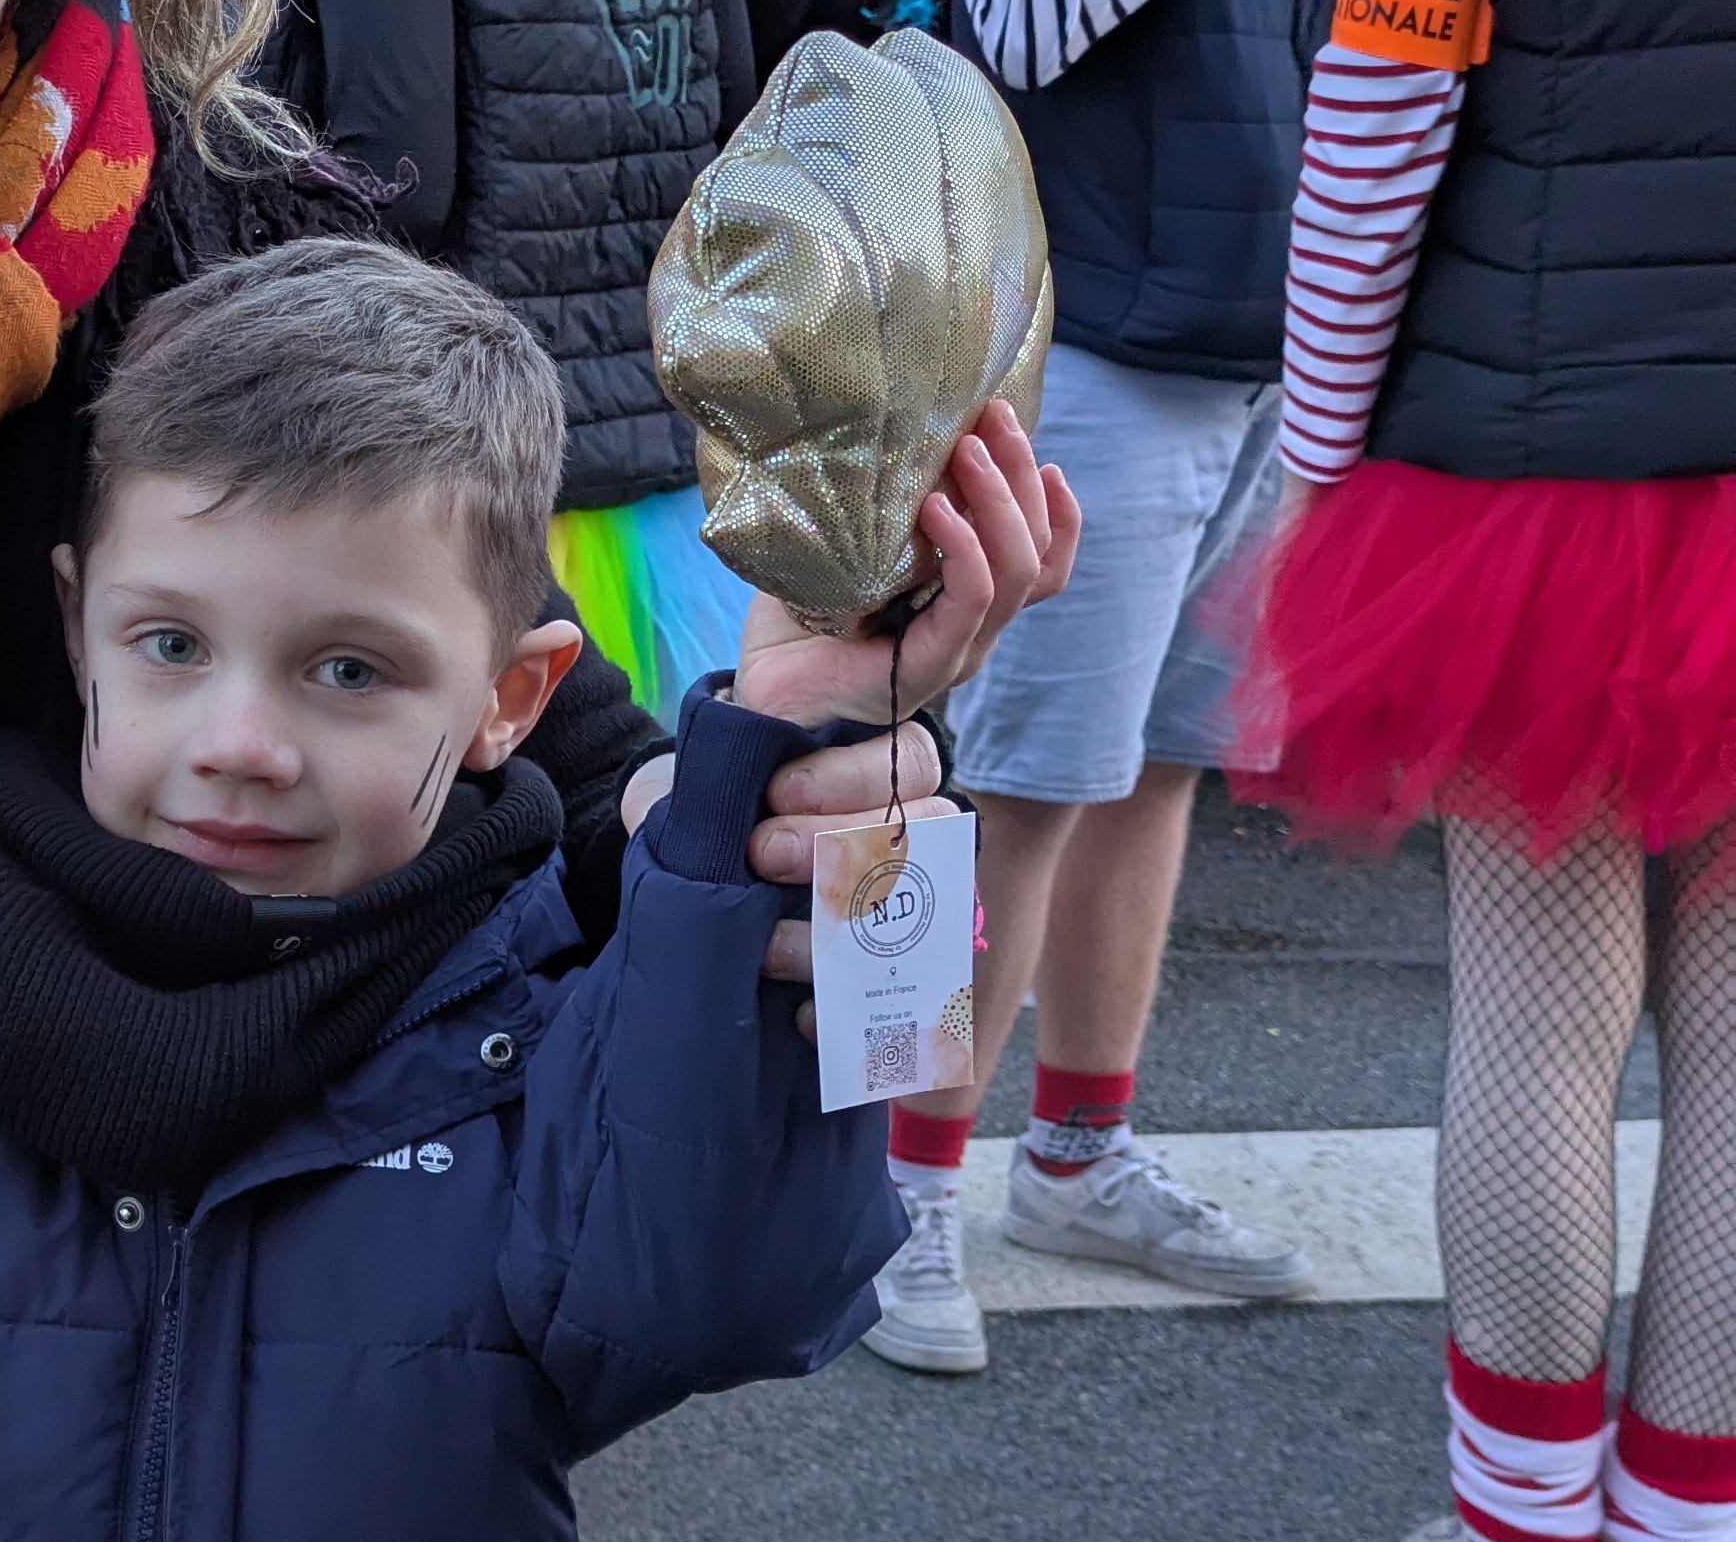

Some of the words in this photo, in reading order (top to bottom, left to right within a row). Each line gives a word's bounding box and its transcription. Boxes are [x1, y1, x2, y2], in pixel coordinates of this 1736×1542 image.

[869, 891, 915, 927] N.D
[865, 989, 884, 999] Made
[893, 984, 917, 995] France
[869, 1013, 892, 1024] Follow
